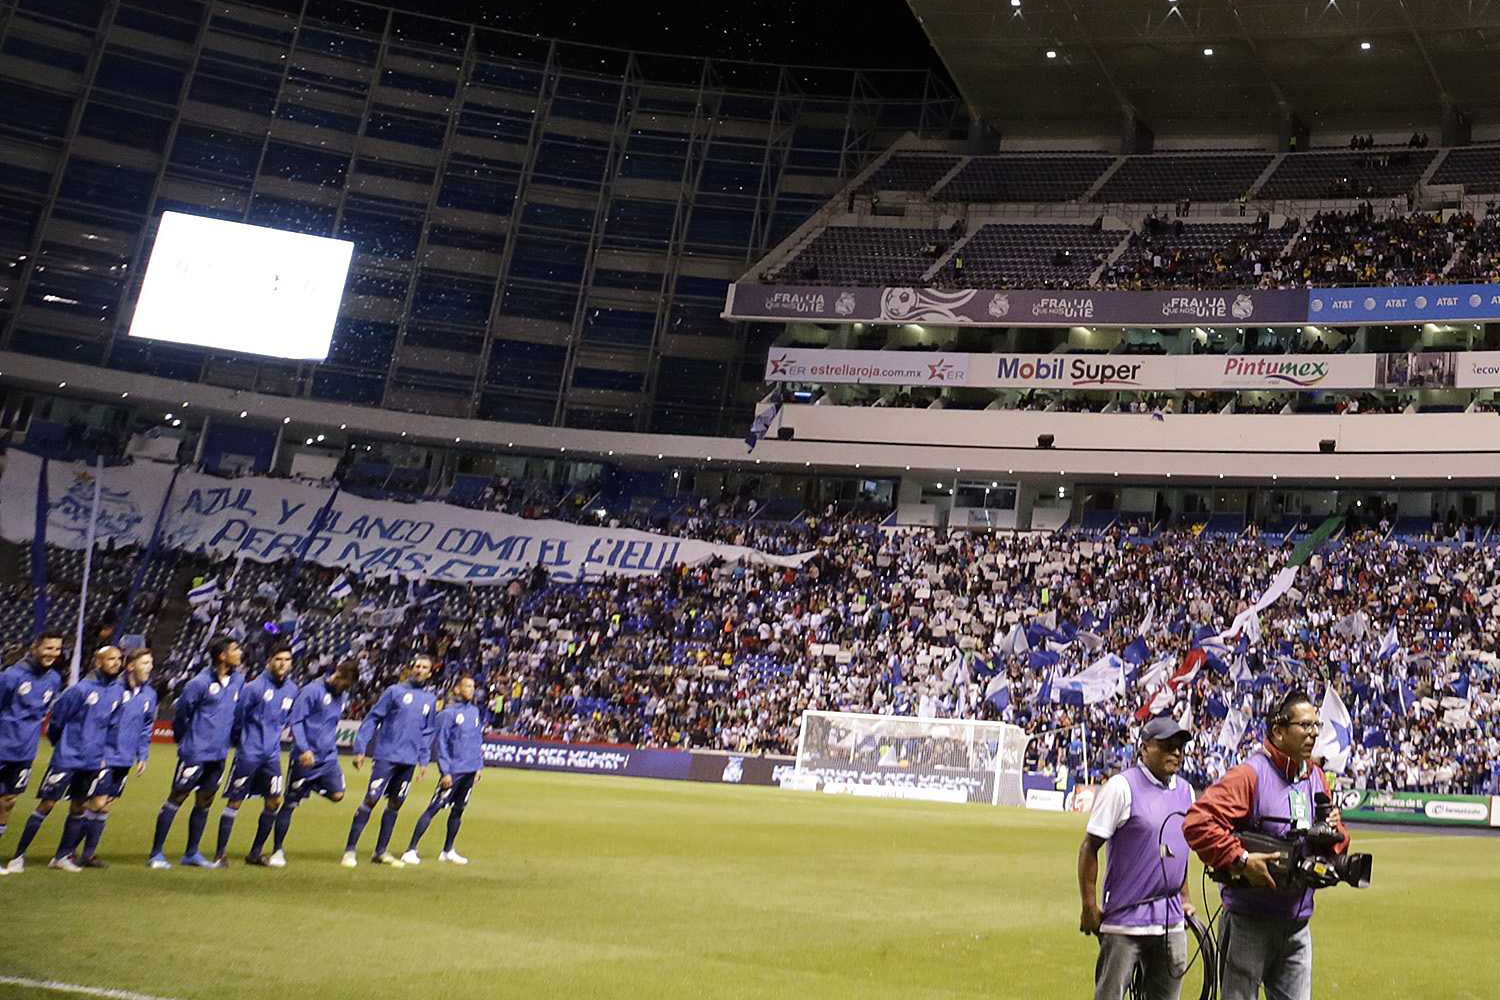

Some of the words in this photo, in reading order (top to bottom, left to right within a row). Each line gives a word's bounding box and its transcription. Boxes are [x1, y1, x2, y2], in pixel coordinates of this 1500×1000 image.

[1332, 300, 1354, 310] AT&T
[1385, 298, 1407, 308] AT&T
[1436, 297, 1459, 307] AT&T
[789, 366, 806, 376] ER
[810, 364, 922, 378] estrellaroja.com.mx
[946, 370, 965, 380] ER
[997, 358, 1064, 379] Mobil
[1070, 358, 1141, 384] Super
[1224, 358, 1325, 376] Pintumex
[180, 488, 257, 516] AZUL
[278, 498, 305, 525] Y
[539, 539, 572, 566] EL
